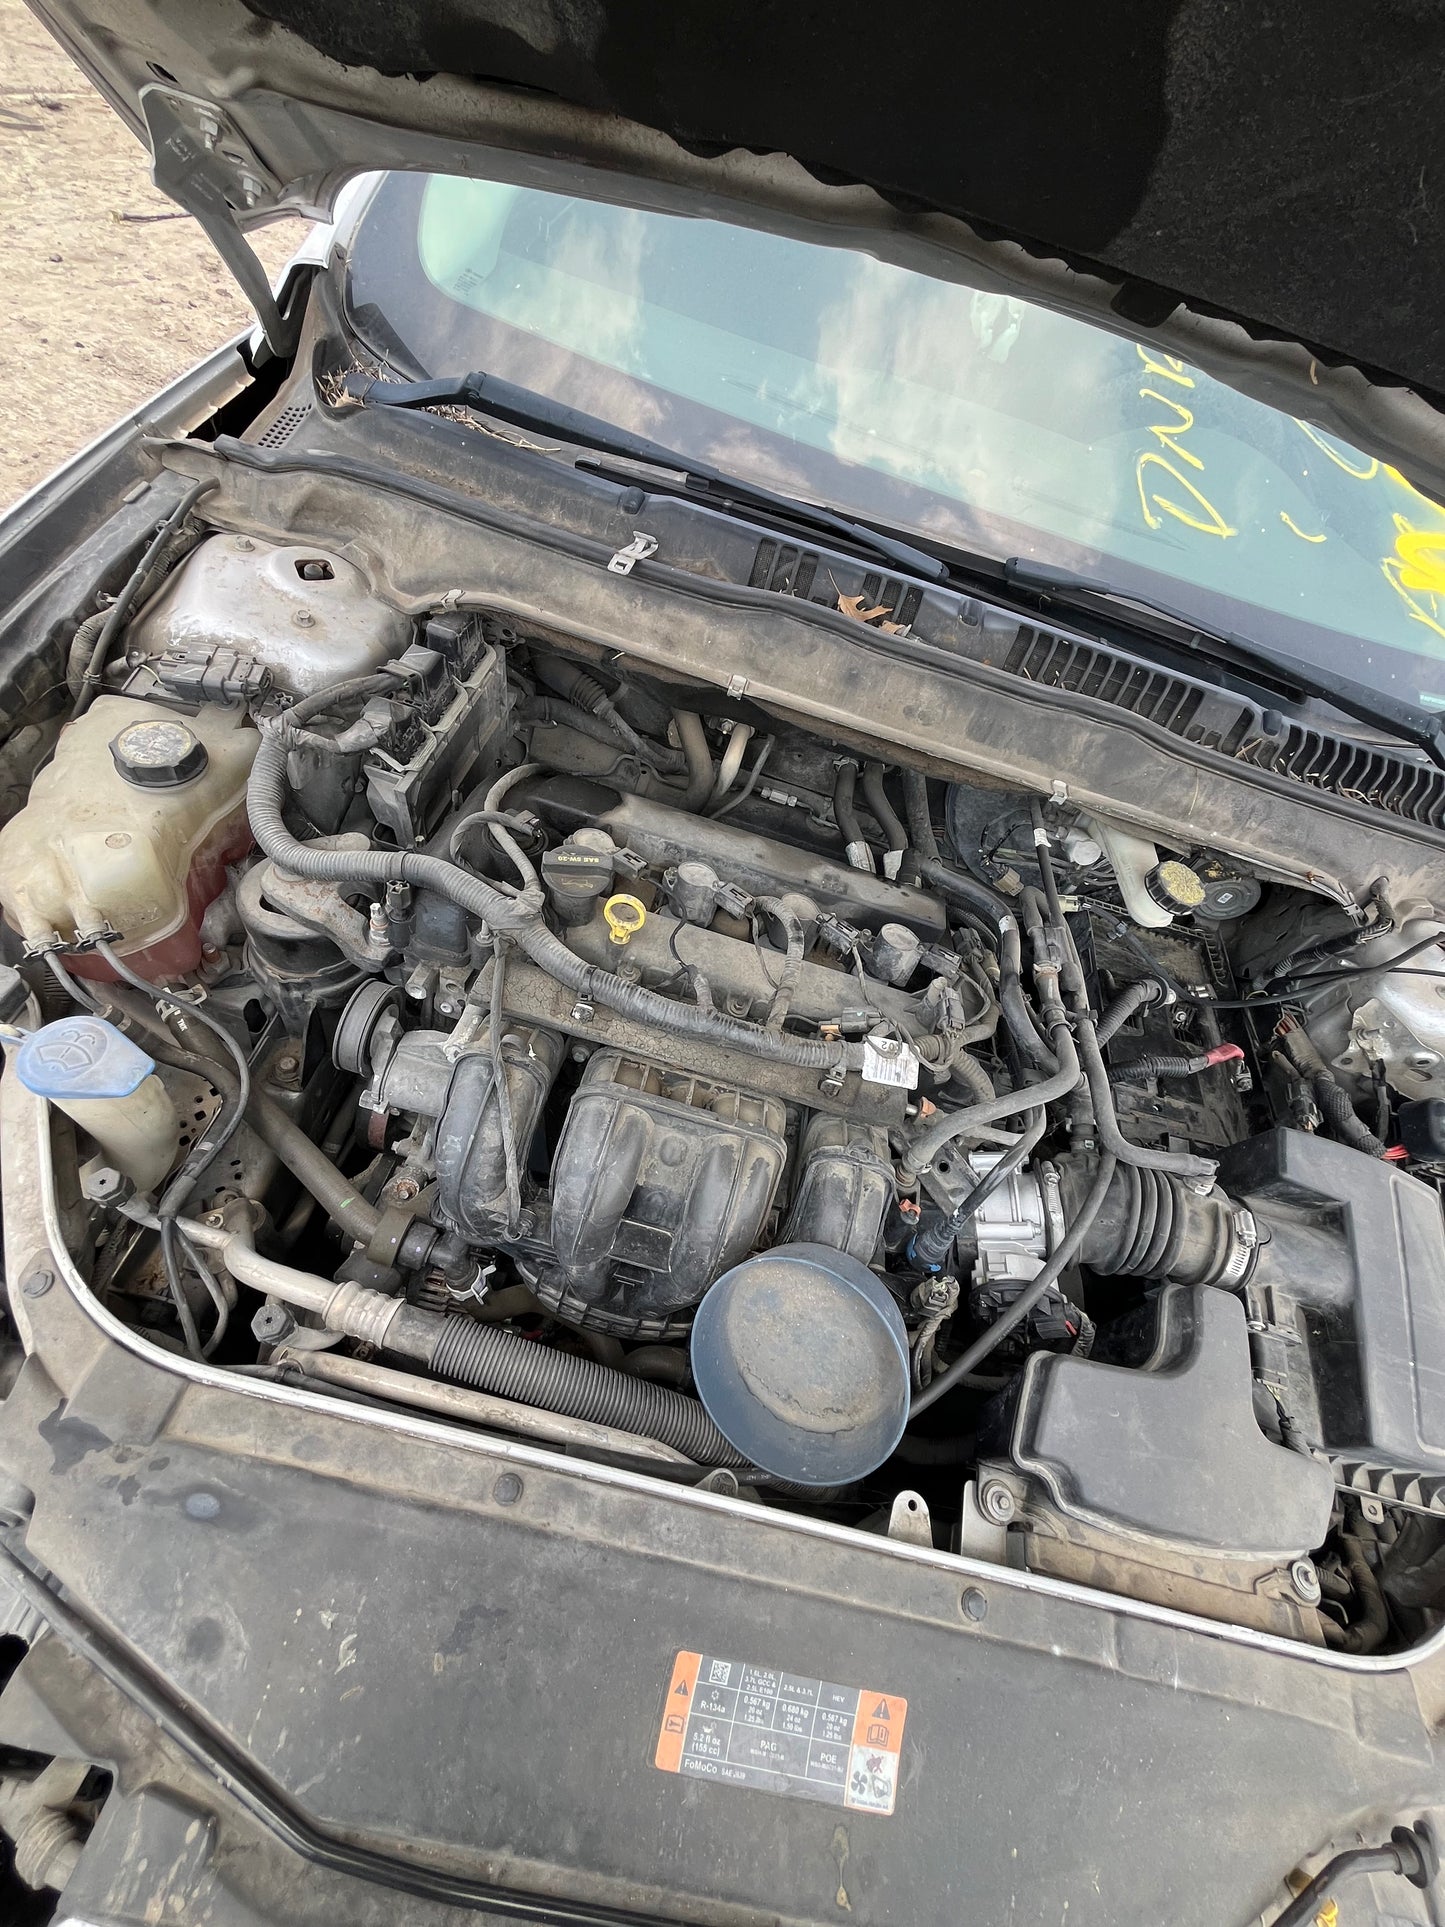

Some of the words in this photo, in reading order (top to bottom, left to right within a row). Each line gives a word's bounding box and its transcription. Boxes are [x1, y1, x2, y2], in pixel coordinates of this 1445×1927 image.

[744, 1695, 761, 1706] 0.567
[762, 1699, 771, 1710] kg
[832, 1694, 845, 1703] HEV
[700, 1700, 726, 1713] R-134a
[782, 1704, 799, 1714] 0.680
[800, 1708, 809, 1719] kg
[839, 1716, 848, 1727] kg
[693, 1732, 704, 1742] 5.2
[705, 1733, 711, 1743] fl
[712, 1737, 721, 1745] oz
[692, 1742, 707, 1753] (155
[708, 1746, 720, 1757] cc)
[760, 1740, 777, 1751] PAG
[820, 1752, 838, 1763] POE
[684, 1758, 718, 1774] FoMoCo
